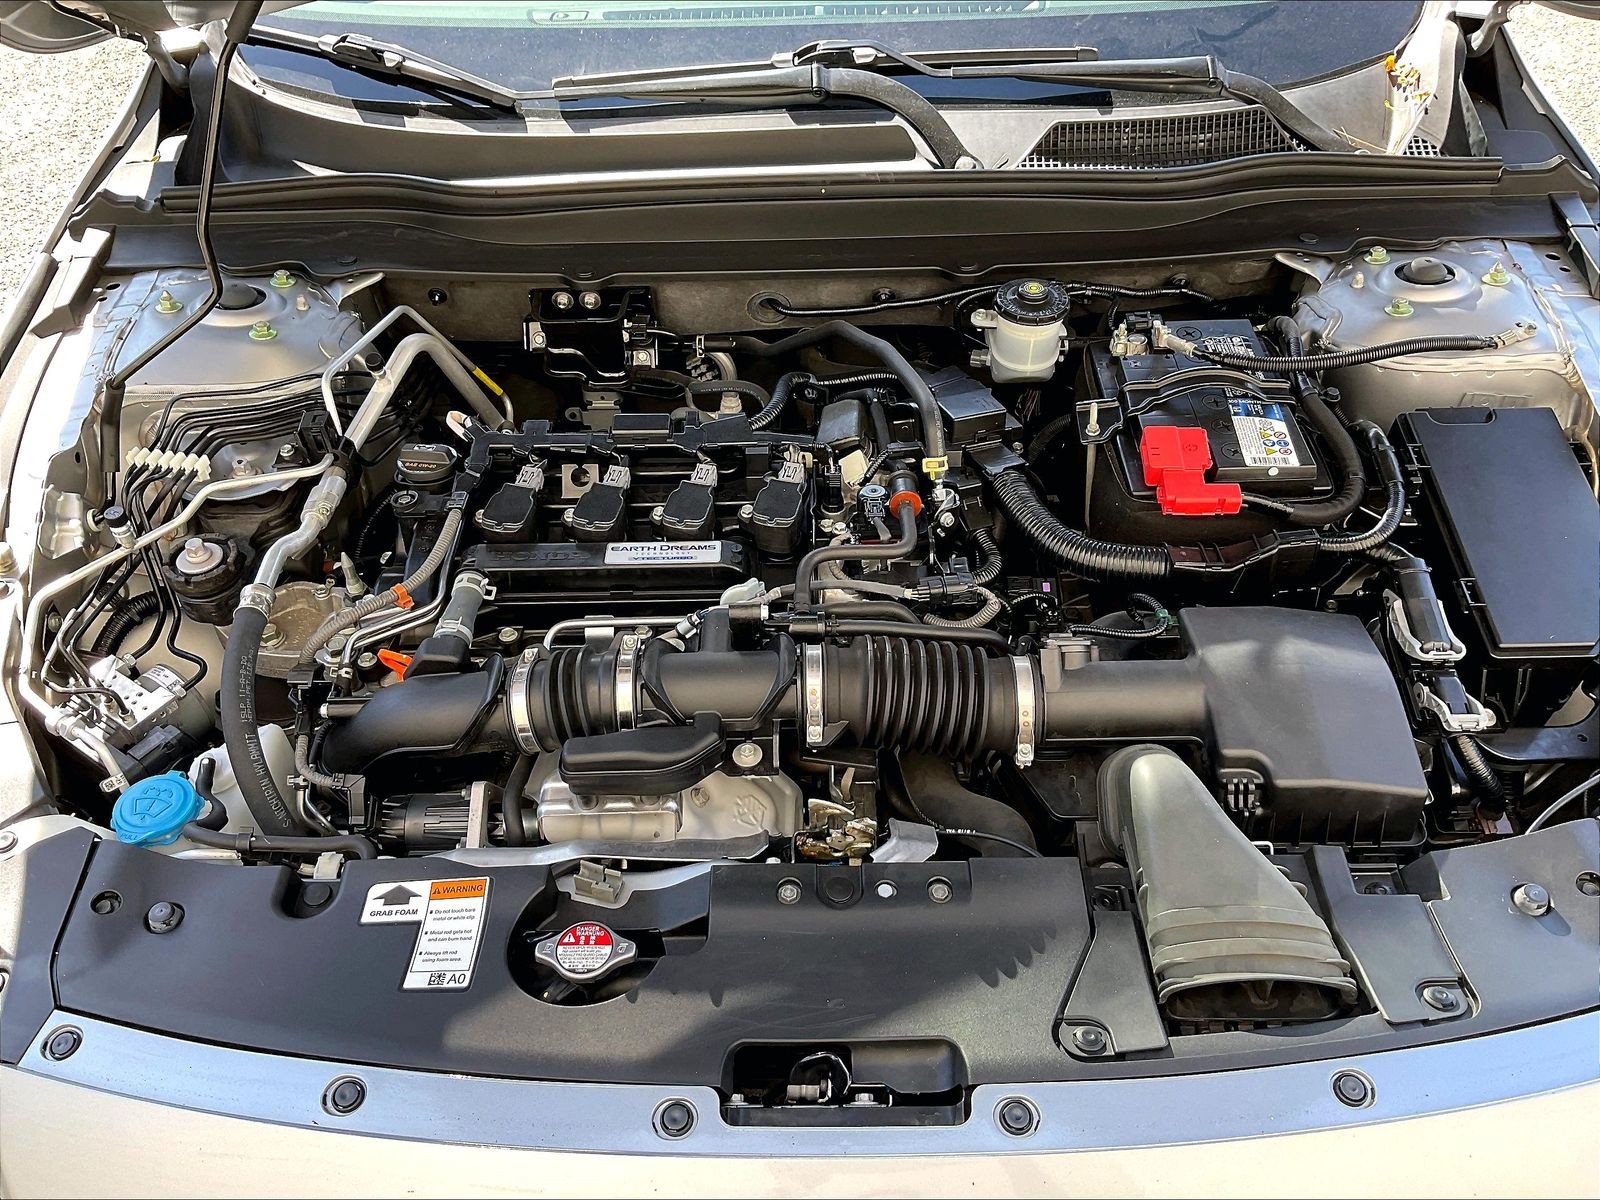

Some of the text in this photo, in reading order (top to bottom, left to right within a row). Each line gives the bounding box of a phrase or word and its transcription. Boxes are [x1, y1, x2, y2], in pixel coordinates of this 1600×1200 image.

[442, 884, 483, 894] WARNING
[394, 908, 419, 916] FOAM
[447, 974, 466, 984] A0
